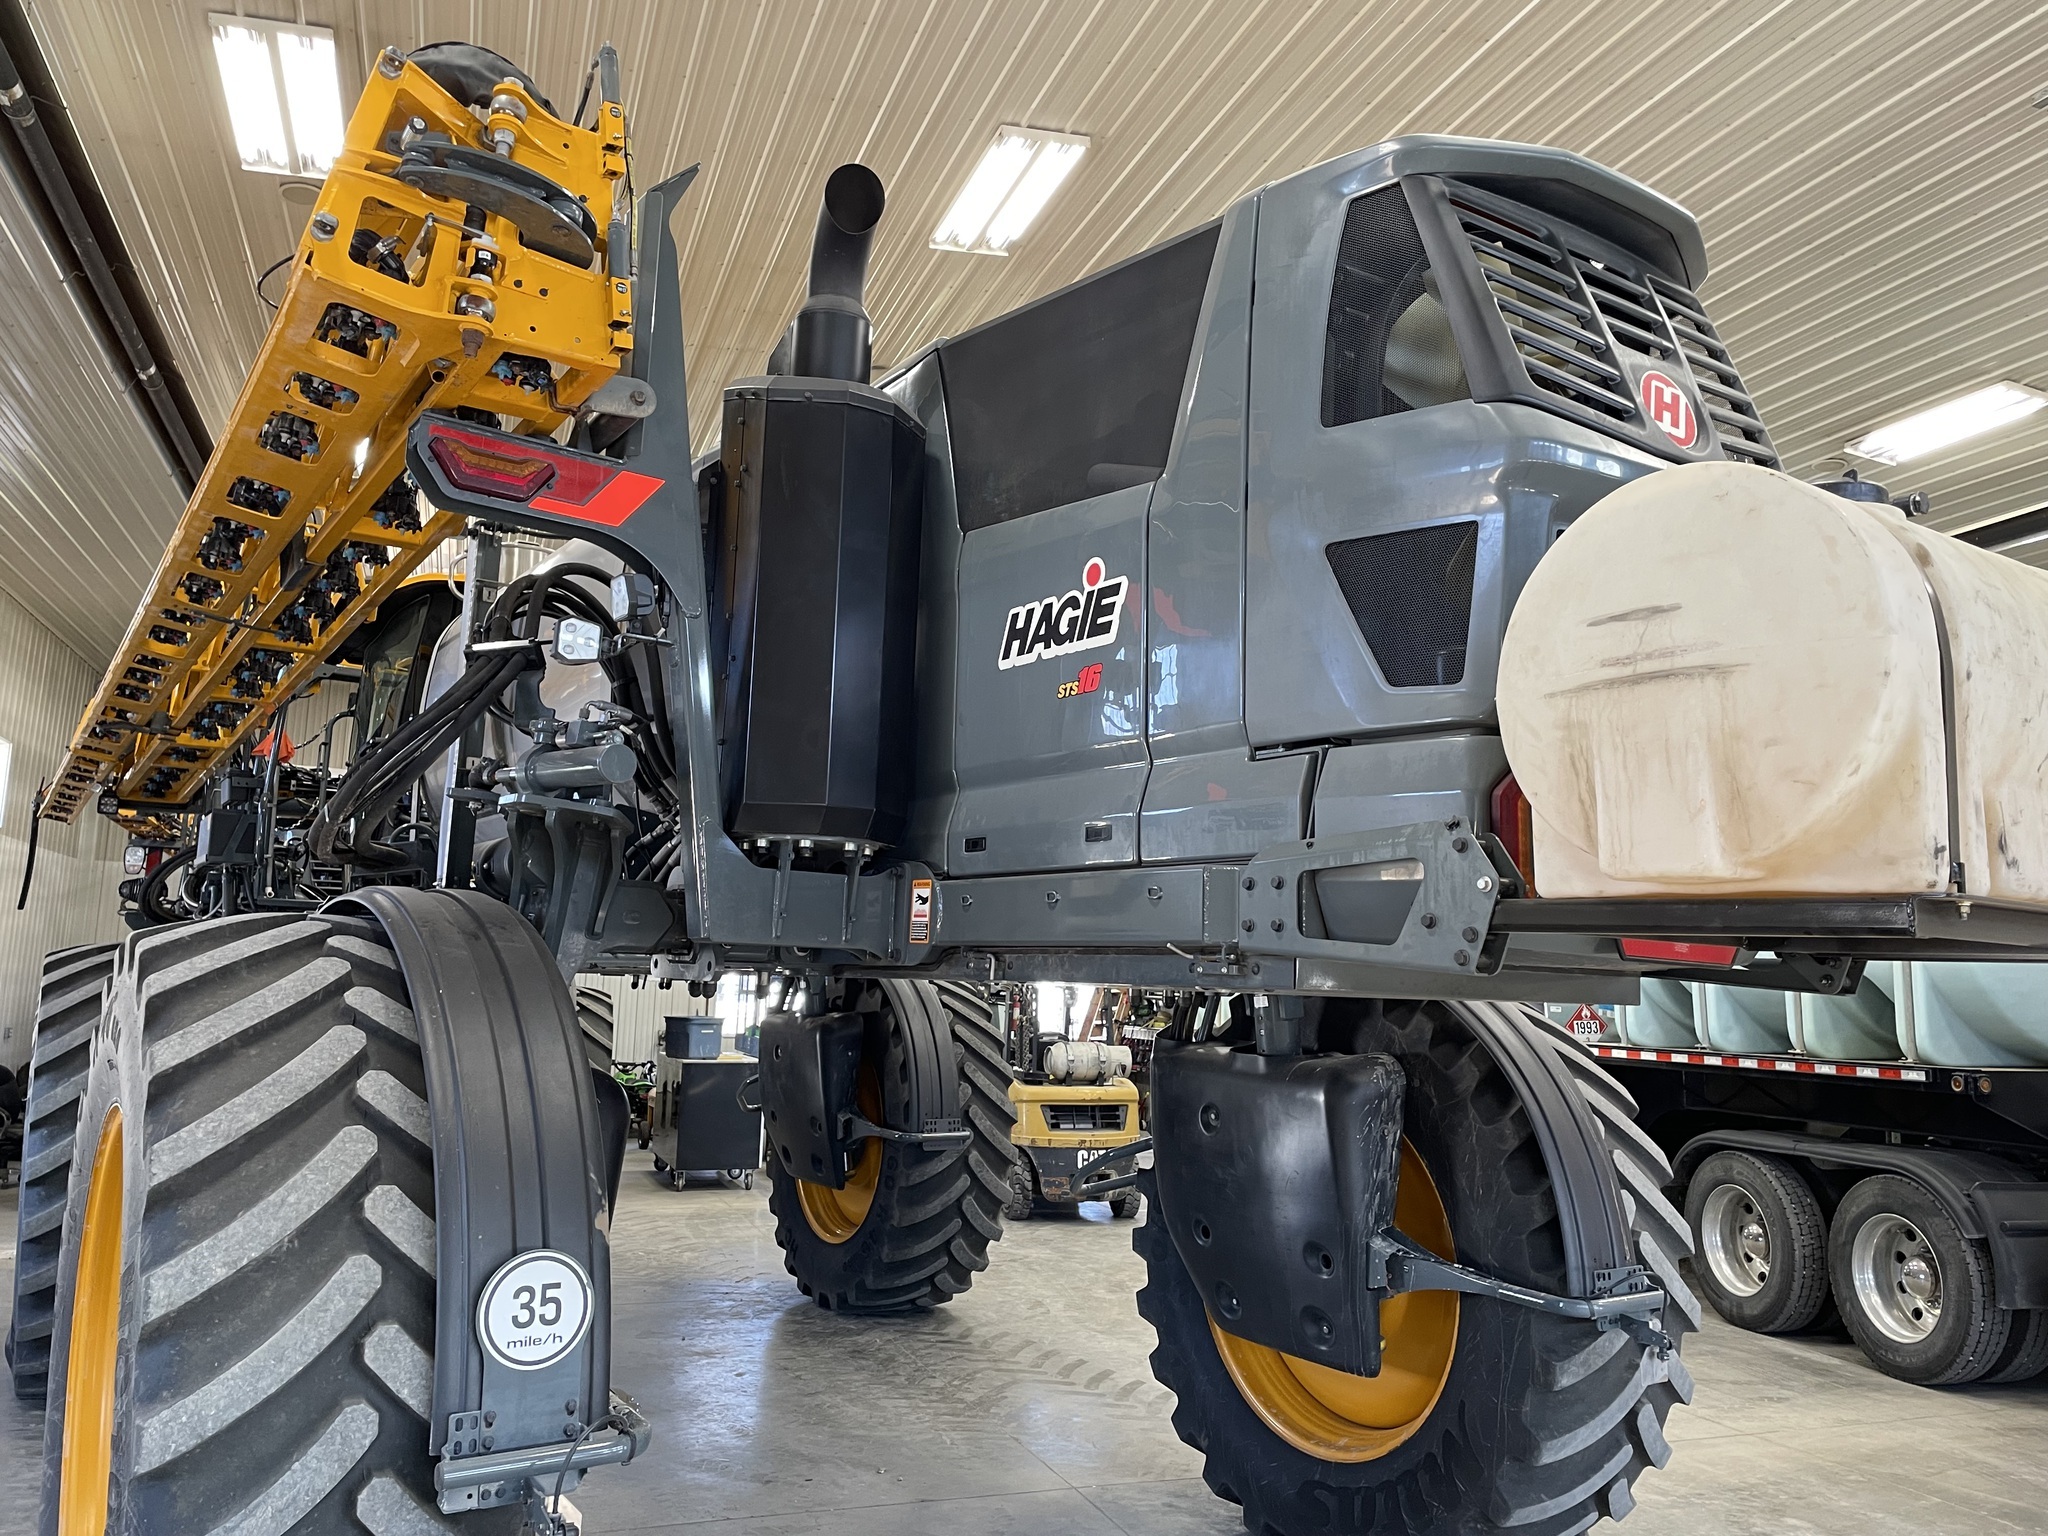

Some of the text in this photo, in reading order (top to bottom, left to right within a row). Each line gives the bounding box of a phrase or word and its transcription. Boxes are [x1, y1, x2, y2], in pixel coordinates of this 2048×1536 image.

[1575, 1021, 1599, 1034] 1993
[511, 1282, 562, 1329] 35
[506, 1333, 563, 1349] mile/h
